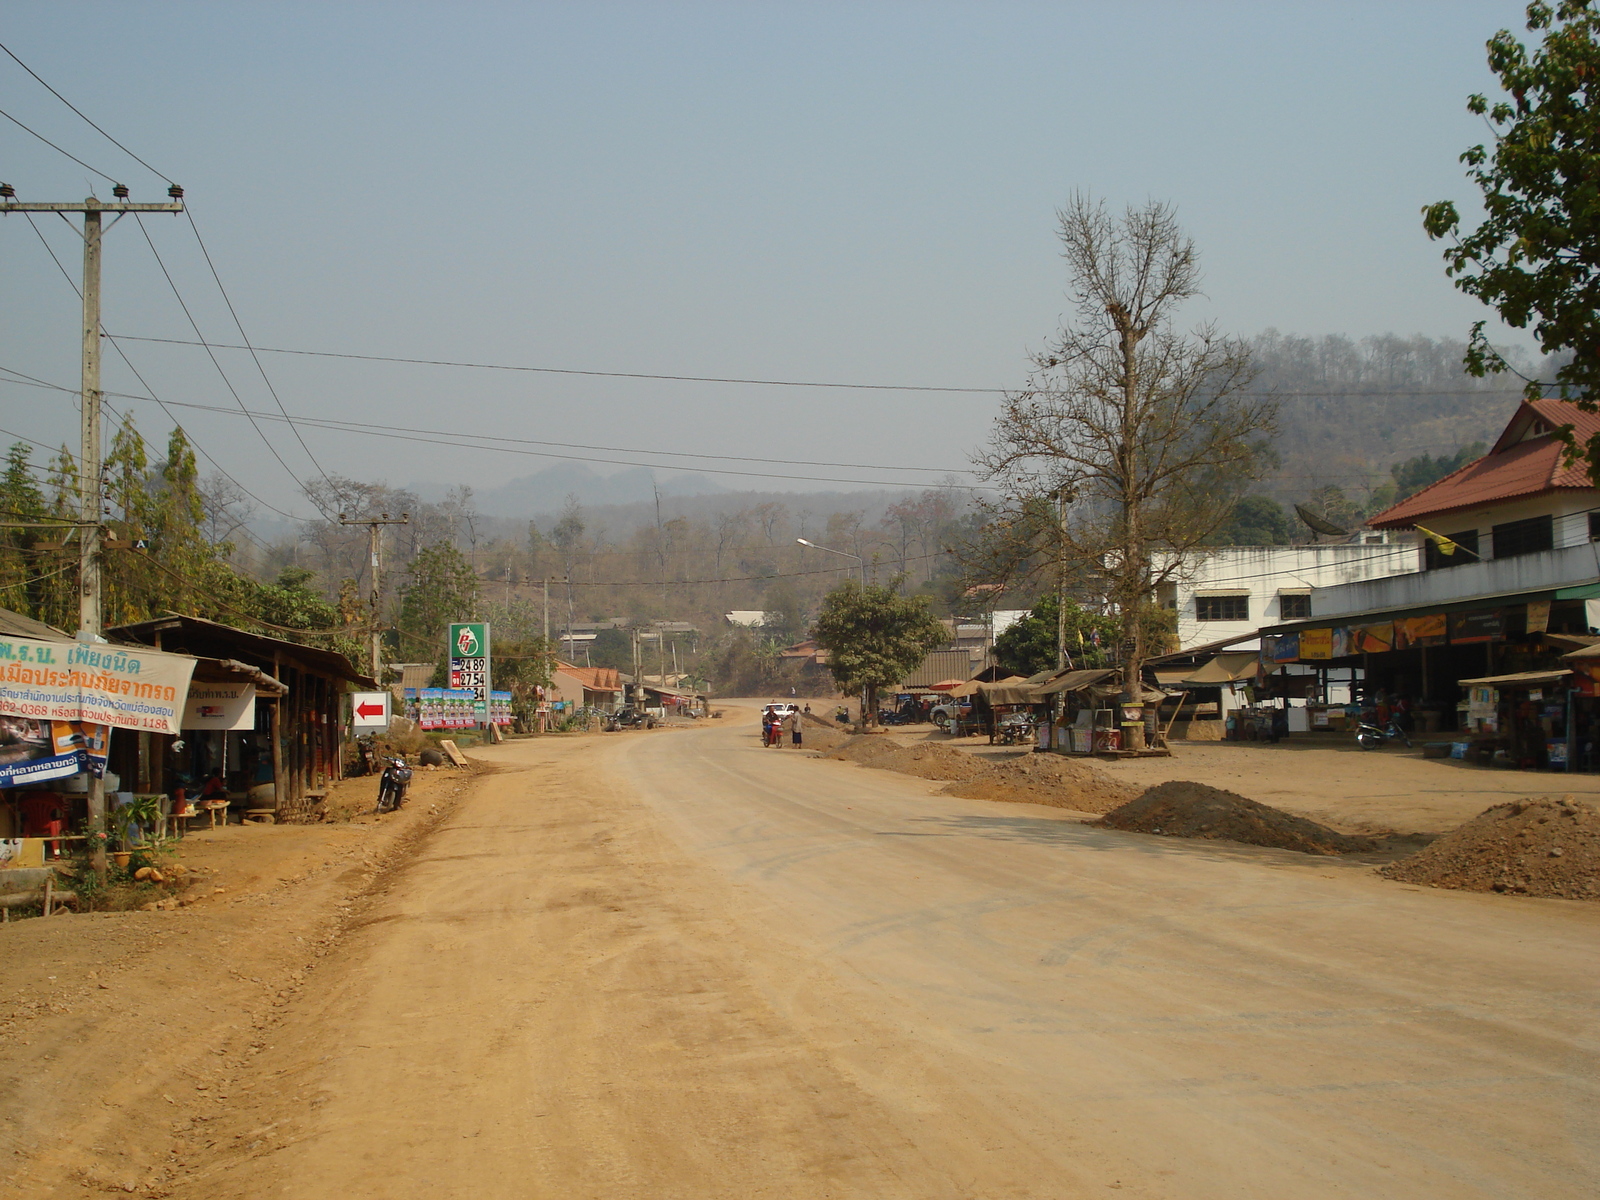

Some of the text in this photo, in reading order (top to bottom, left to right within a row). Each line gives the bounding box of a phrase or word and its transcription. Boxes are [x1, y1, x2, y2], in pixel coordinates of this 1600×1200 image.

[459, 634, 474, 652] PT
[460, 658, 485, 672] 24.89
[452, 677, 460, 685] 91
[460, 673, 485, 686] 27.54
[143, 717, 168, 730] 1186
